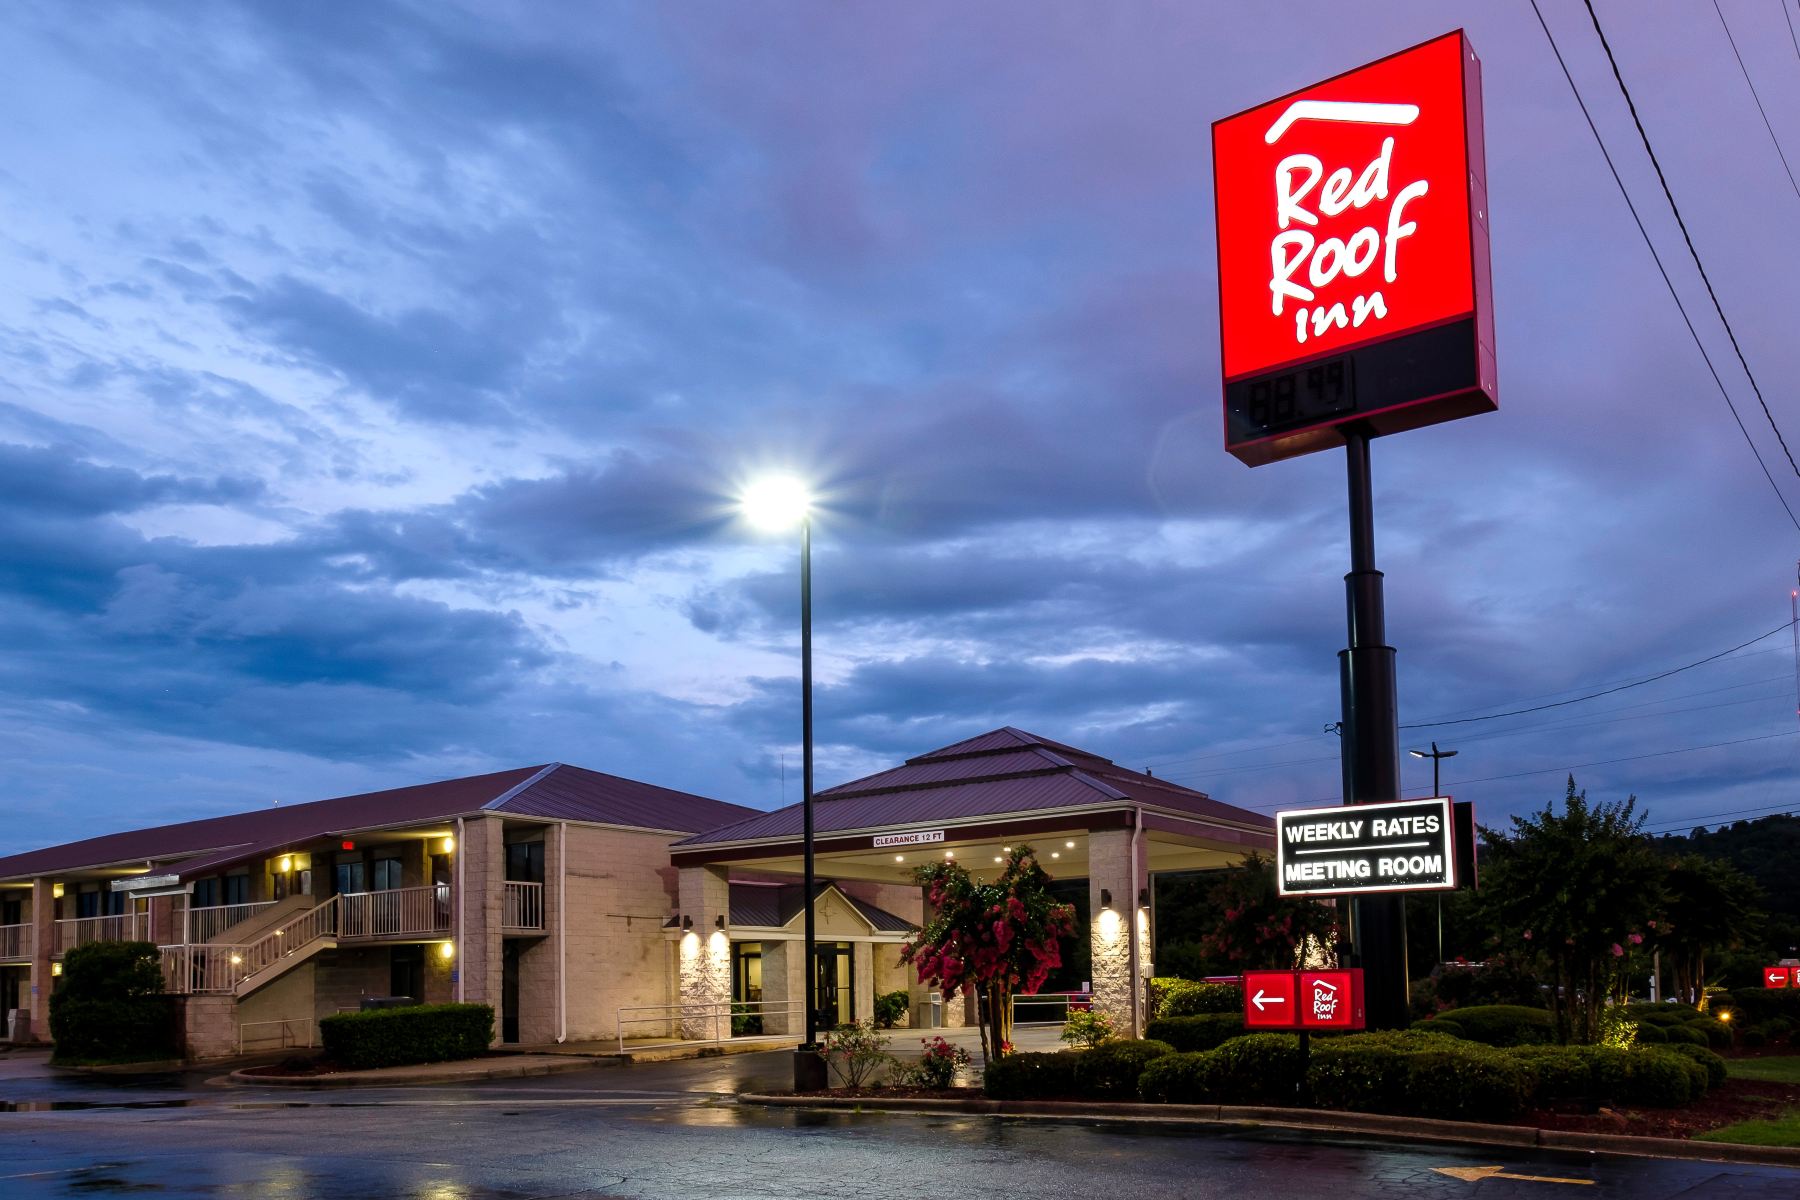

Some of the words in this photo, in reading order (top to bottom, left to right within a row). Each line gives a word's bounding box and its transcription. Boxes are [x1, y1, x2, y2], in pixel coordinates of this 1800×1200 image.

[1276, 137, 1395, 231] Red
[1269, 179, 1429, 317] Roof
[875, 834, 920, 846] CLEARANCE
[922, 833, 930, 841] 12
[1285, 820, 1364, 843] WEEKLY
[1372, 815, 1440, 837] RATES
[1285, 859, 1371, 882] MEETING
[1378, 854, 1442, 877] ROOM
[1313, 999, 1338, 1014] Roof
[1314, 988, 1333, 1002] Red
